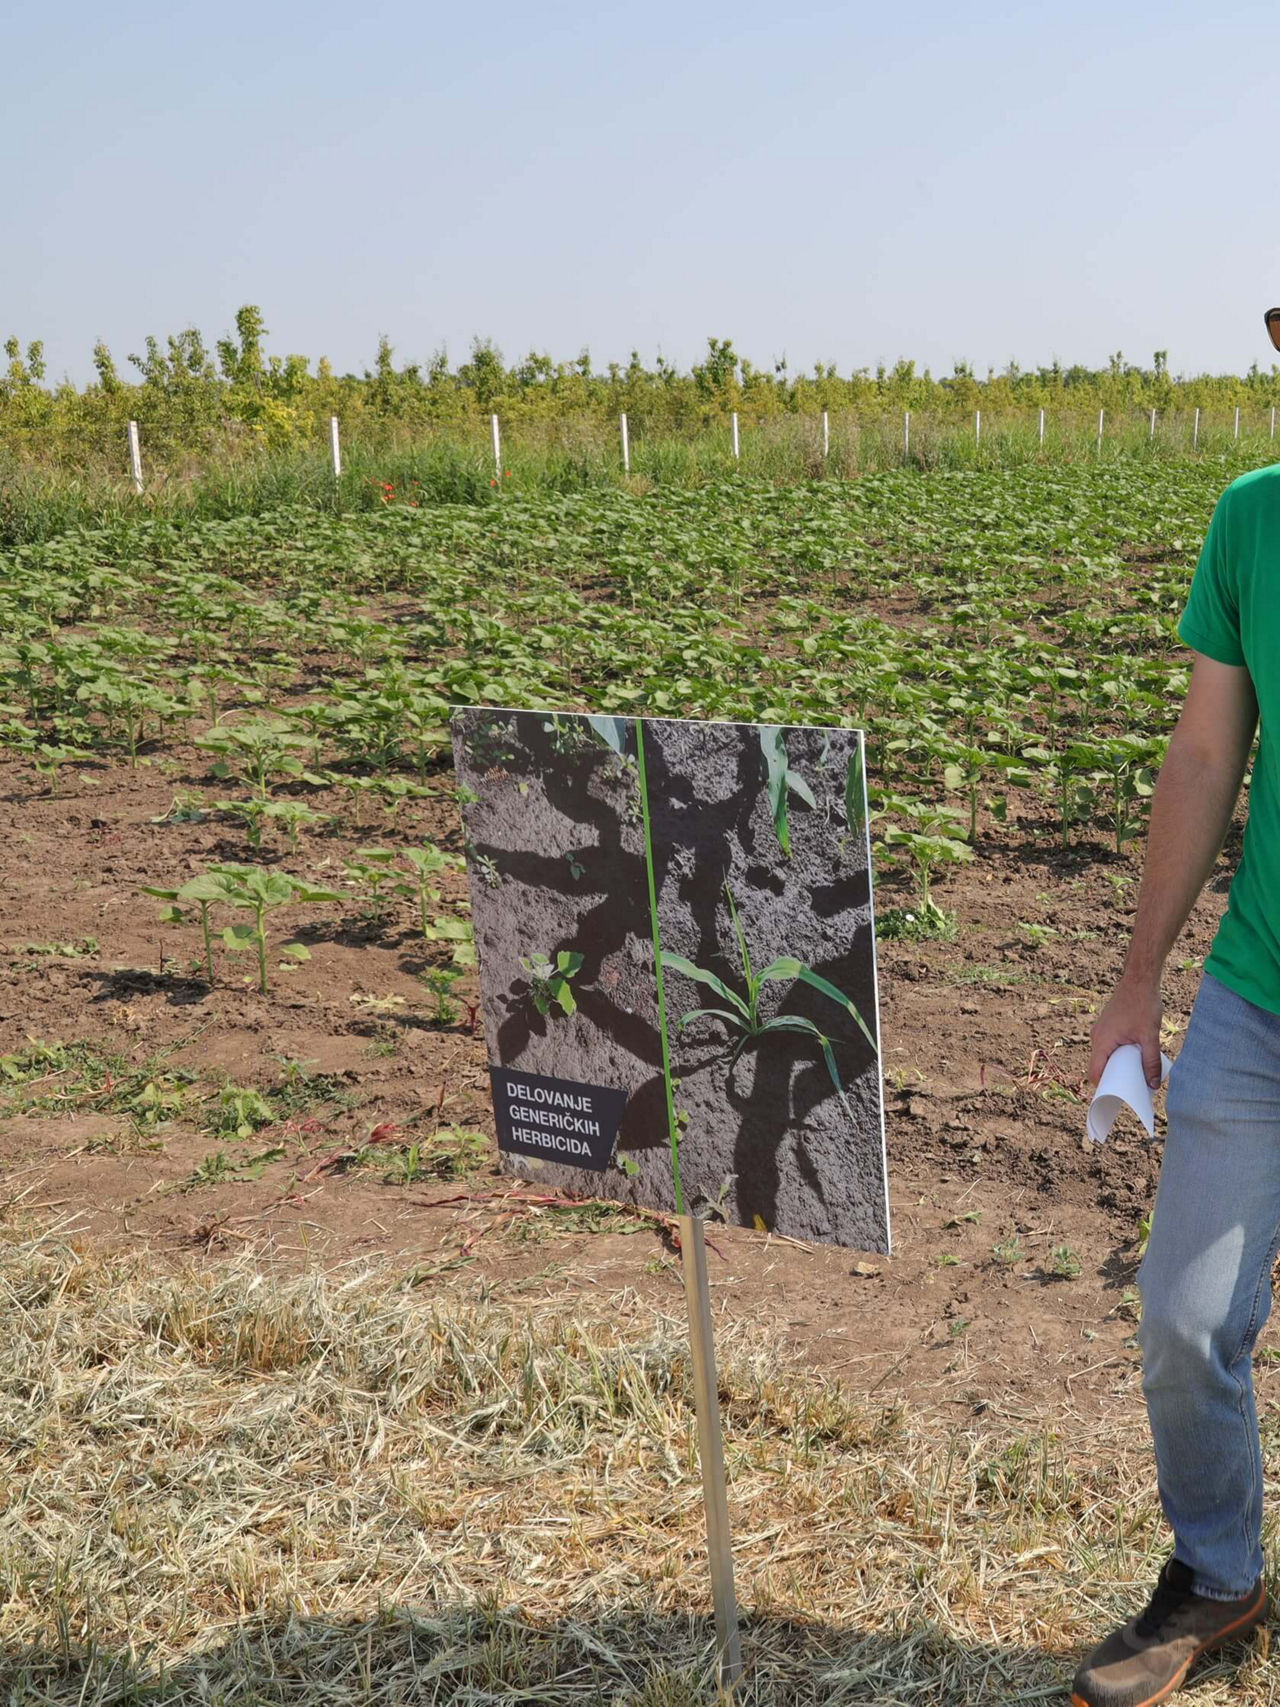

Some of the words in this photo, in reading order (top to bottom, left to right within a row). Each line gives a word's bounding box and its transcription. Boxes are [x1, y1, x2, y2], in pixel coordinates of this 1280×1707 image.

[506, 1082, 593, 1113] DELOVANJE
[509, 1104, 600, 1137] GENERIČKIH
[512, 1126, 592, 1157] HERBICIDA
